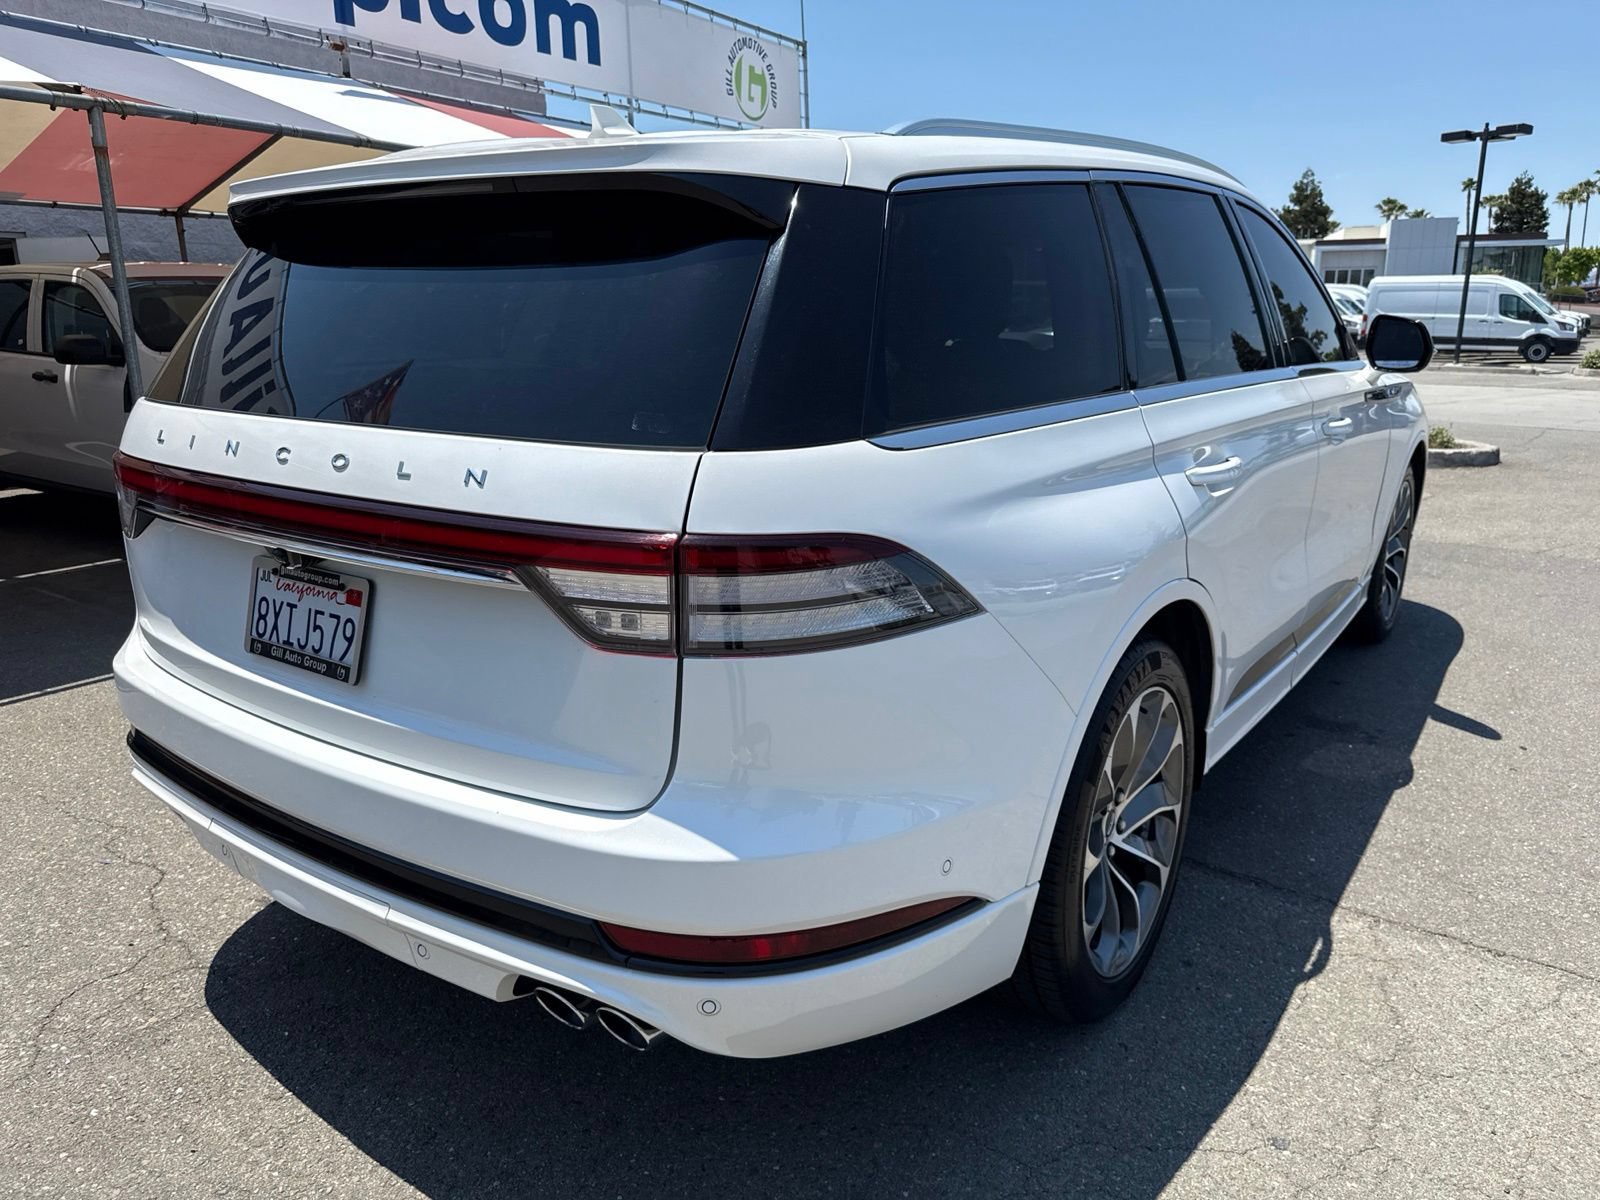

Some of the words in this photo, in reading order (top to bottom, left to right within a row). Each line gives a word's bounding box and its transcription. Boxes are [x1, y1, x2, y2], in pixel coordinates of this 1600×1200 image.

[728, 37, 768, 68] AUTOMOTIVE
[766, 63, 777, 109] GROUP
[157, 429, 488, 489] LINCOLN
[255, 596, 356, 662] 8XIJ579
[271, 646, 284, 658] Gill
[284, 650, 302, 664] Auto
[303, 656, 327, 673] Group
